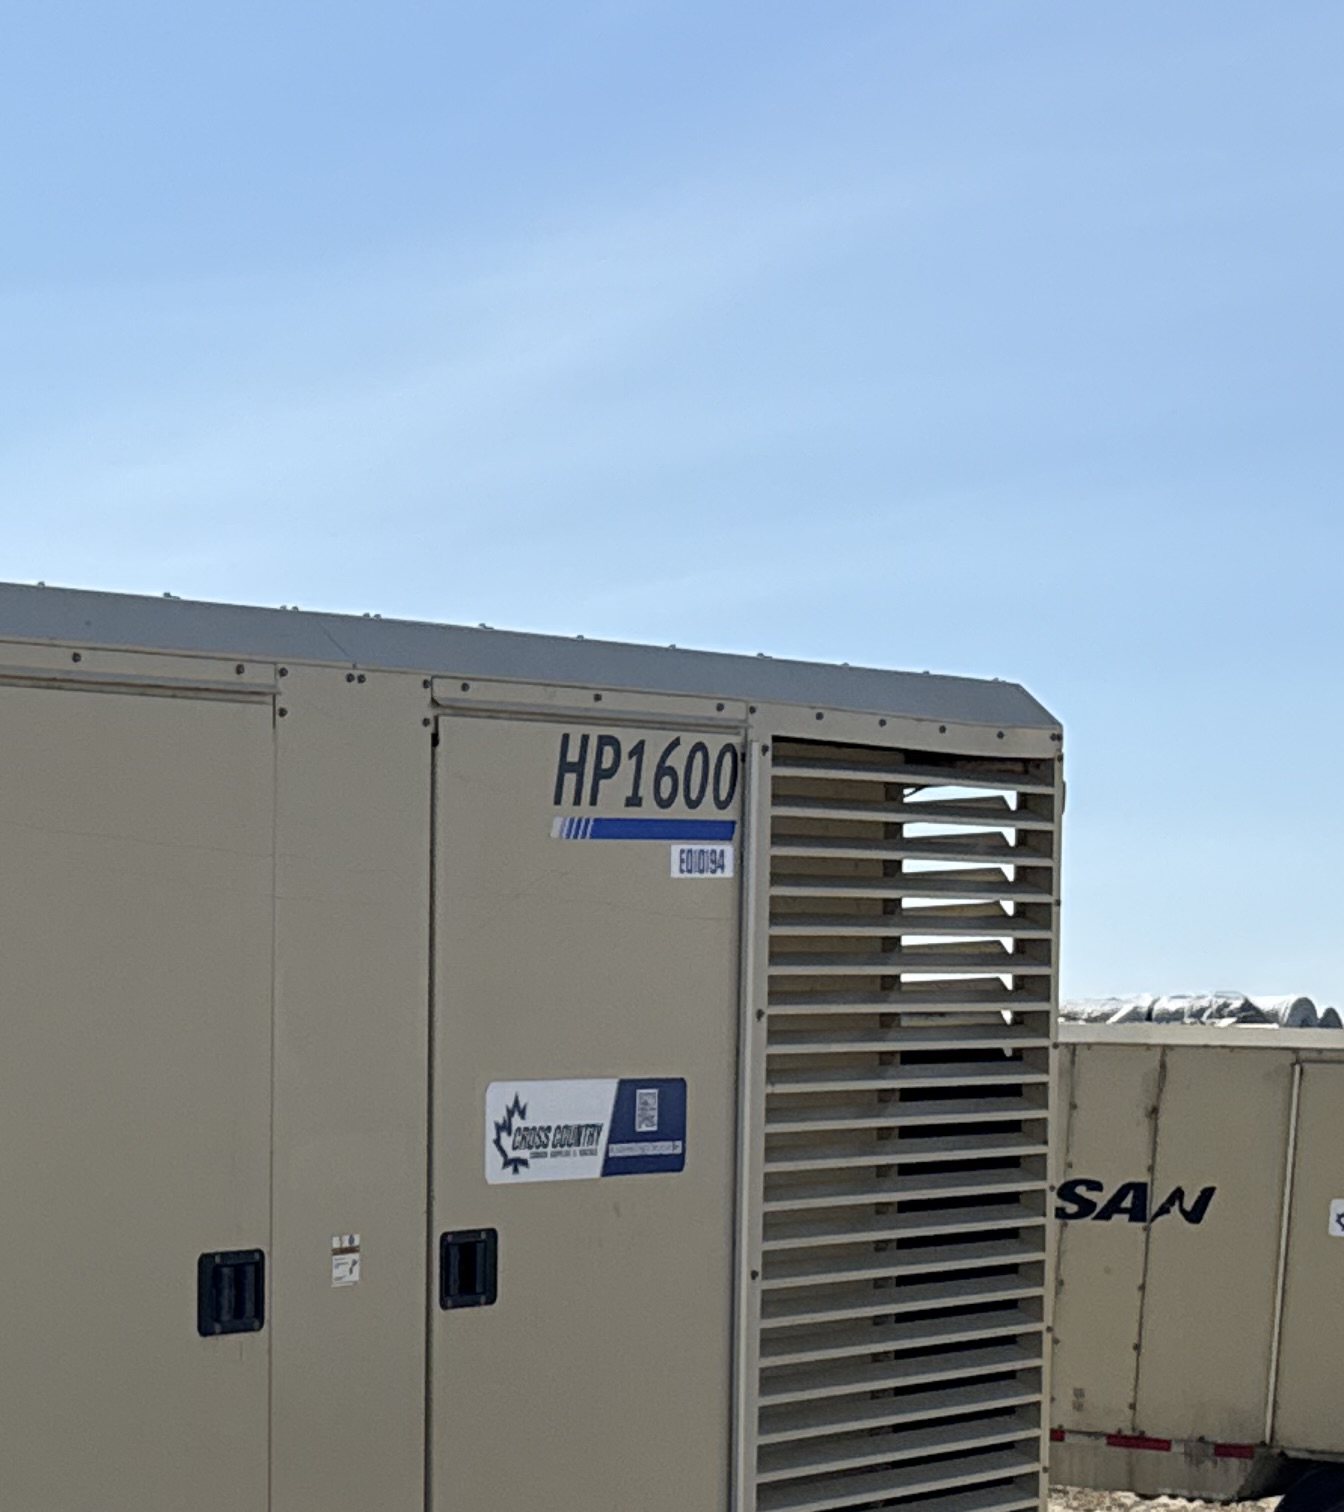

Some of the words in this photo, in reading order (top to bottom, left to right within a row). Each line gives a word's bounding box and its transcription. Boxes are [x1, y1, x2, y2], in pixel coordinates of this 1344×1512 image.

[553, 733, 738, 810] HP1600
[512, 1125, 552, 1151] CROSS
[552, 1123, 604, 1148] COUNTRY
